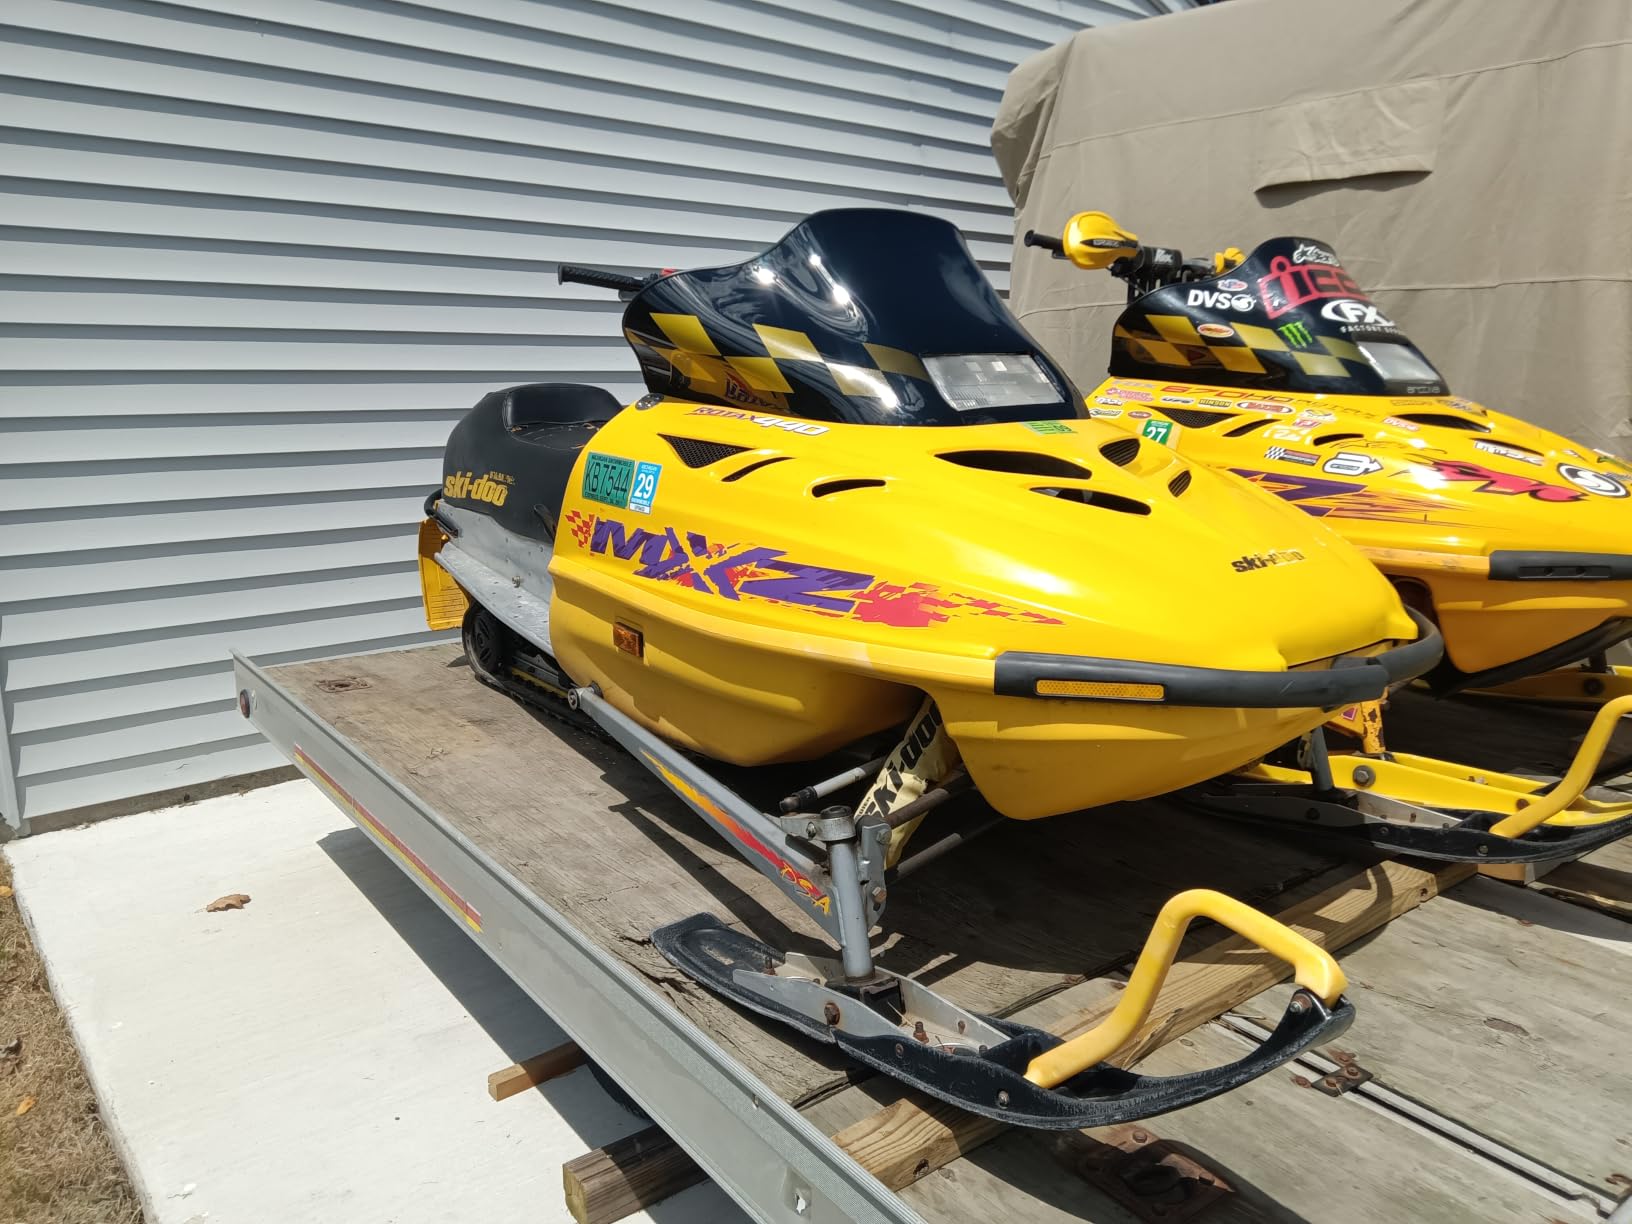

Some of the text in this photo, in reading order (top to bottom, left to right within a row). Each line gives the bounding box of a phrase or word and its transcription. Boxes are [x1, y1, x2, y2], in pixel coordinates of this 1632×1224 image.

[1187, 289, 1232, 309] DVS
[686, 406, 831, 436] ROTAX 440
[1146, 426, 1168, 444] 27
[443, 471, 508, 507] ski-doo
[633, 472, 655, 499] 29
[589, 516, 876, 613] MXZ
